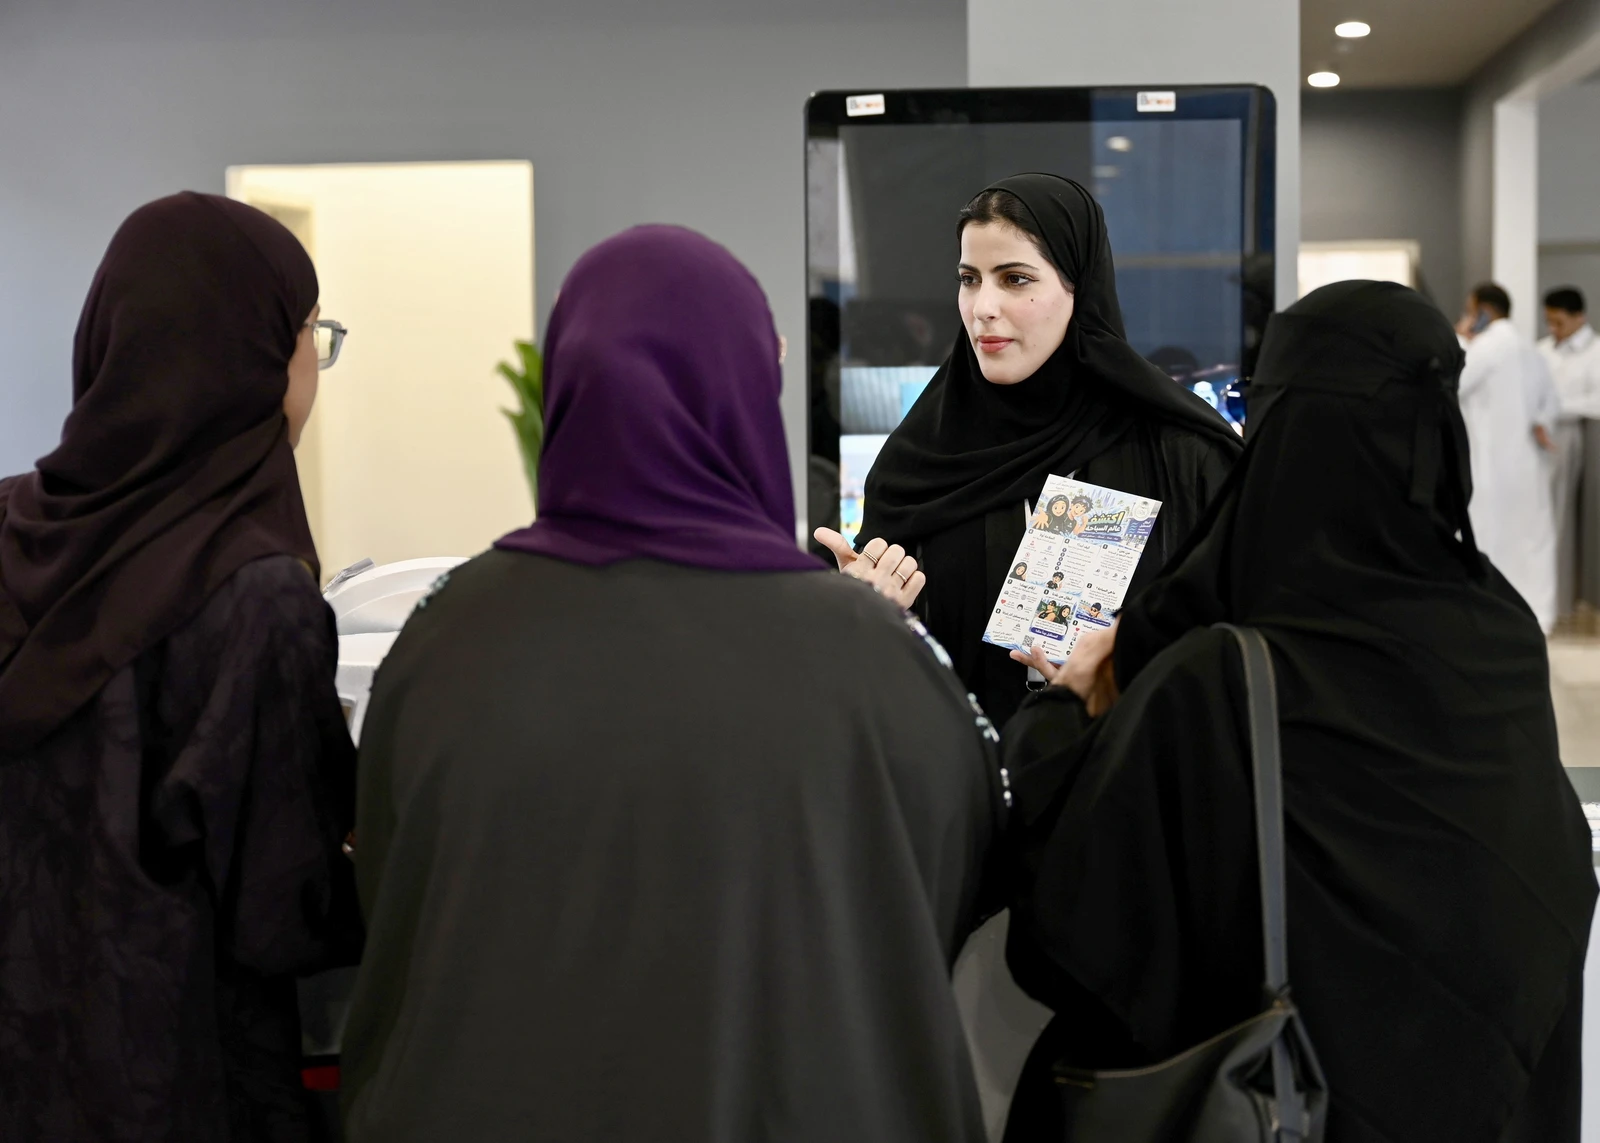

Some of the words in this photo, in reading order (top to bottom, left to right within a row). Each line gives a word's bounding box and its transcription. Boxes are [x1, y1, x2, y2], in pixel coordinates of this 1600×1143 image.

[1088, 511, 1125, 525] اكتشف
[1086, 524, 1108, 532] السباحة
[1107, 524, 1120, 532] عالم
